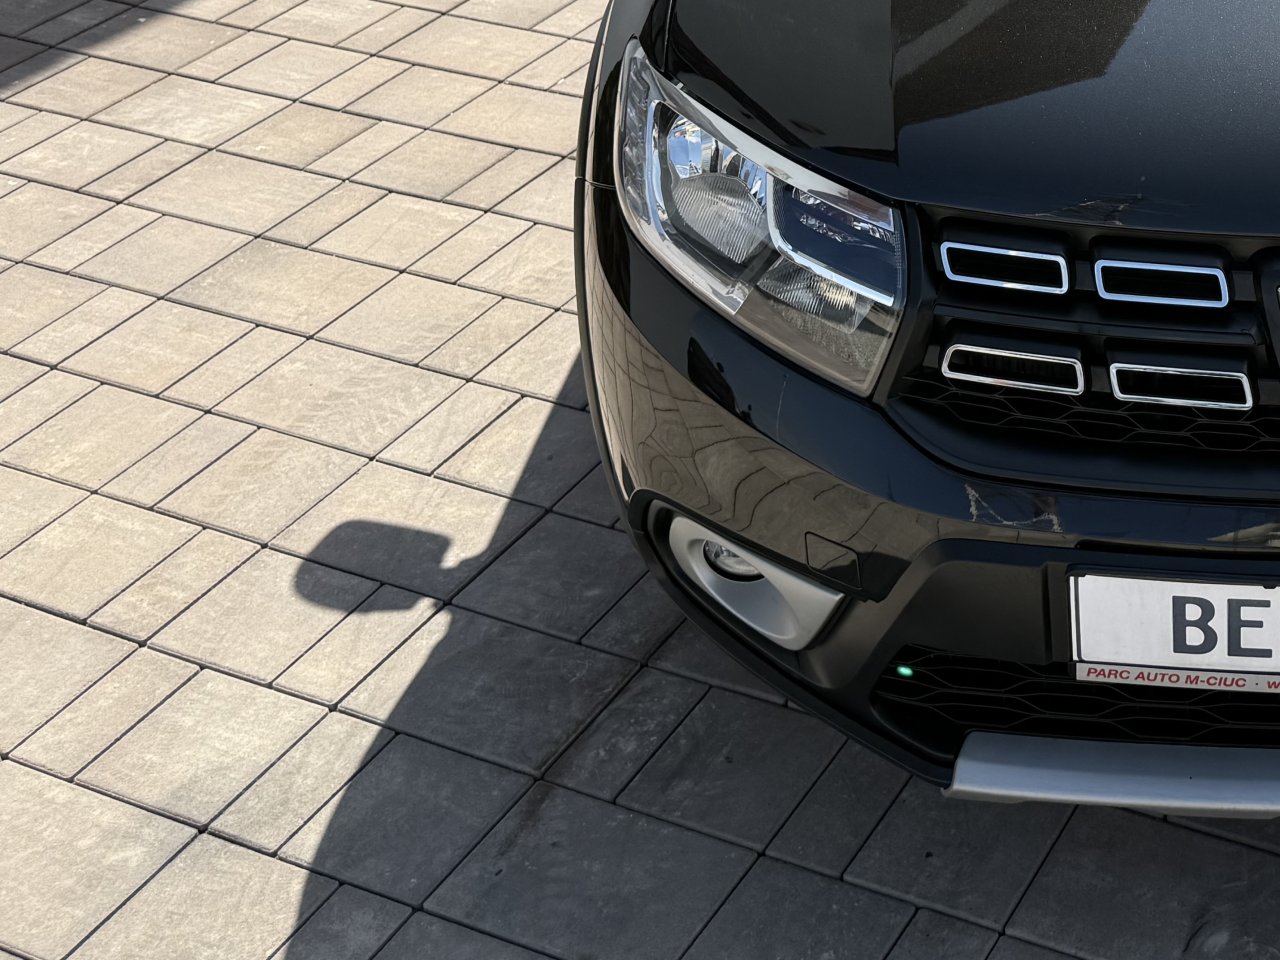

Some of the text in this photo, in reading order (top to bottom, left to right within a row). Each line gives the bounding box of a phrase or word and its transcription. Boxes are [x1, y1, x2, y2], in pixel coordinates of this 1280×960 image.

[1086, 667, 1131, 681] PARC
[1134, 670, 1181, 684] AUTO
[1184, 674, 1247, 688] M-CIUC
